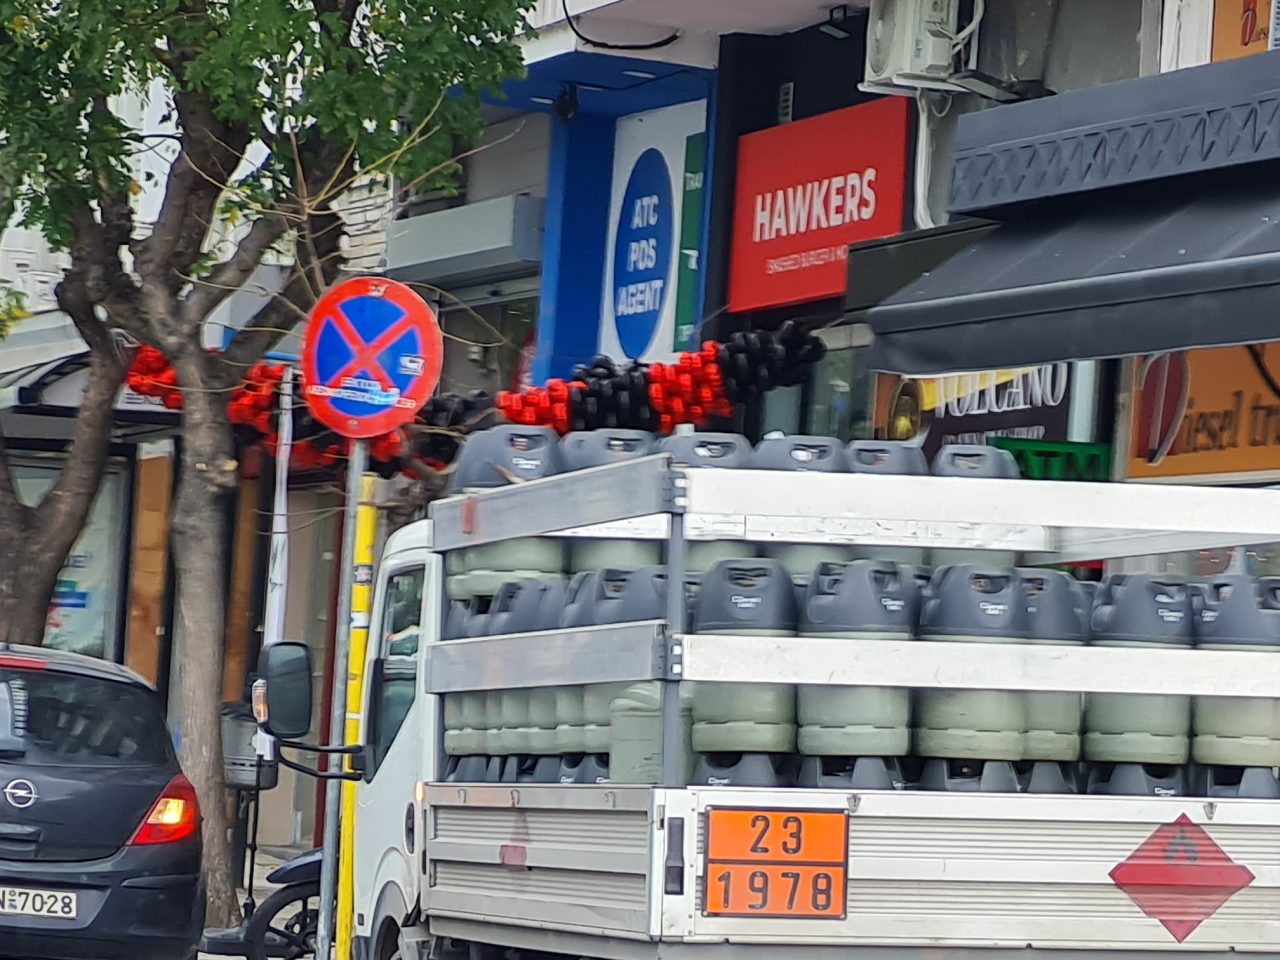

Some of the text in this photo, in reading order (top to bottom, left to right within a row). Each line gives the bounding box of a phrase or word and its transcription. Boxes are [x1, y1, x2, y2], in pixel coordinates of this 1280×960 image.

[631, 194, 660, 230] ATC
[753, 167, 877, 242] HAWKERS
[626, 238, 657, 272] POS
[617, 279, 664, 317] AGENT
[935, 364, 1068, 418] VOLCANO
[750, 815, 802, 854] 23
[718, 870, 832, 911] 1978
